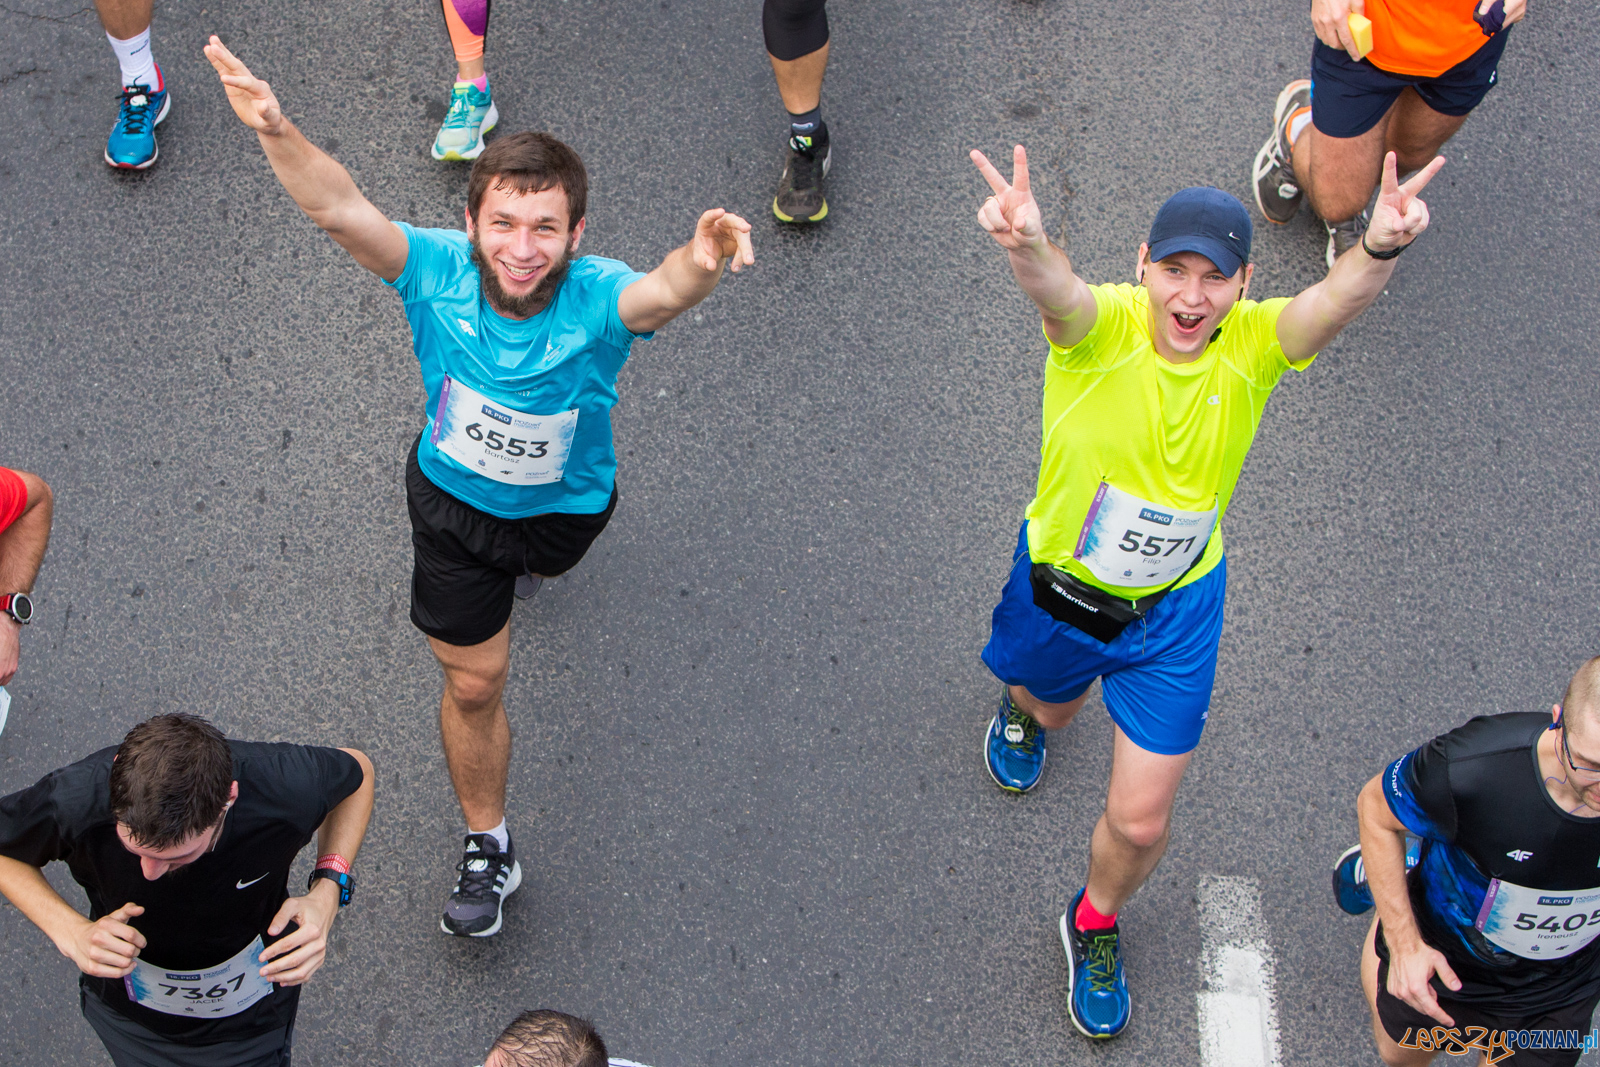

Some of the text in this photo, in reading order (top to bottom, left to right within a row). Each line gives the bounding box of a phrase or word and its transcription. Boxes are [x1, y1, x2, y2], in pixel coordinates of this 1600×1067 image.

[484, 407, 510, 422] 18. PKO
[465, 422, 550, 459] 6553
[484, 448, 520, 464] Bartosz
[1143, 511, 1170, 523] 18. PKO
[1118, 529, 1197, 557] 5571
[1142, 557, 1161, 565] Filip
[1061, 589, 1099, 613] karrimor
[1506, 849, 1534, 862] 4F
[1537, 931, 1579, 939] Ireneusz
[158, 972, 246, 1000] 7367
